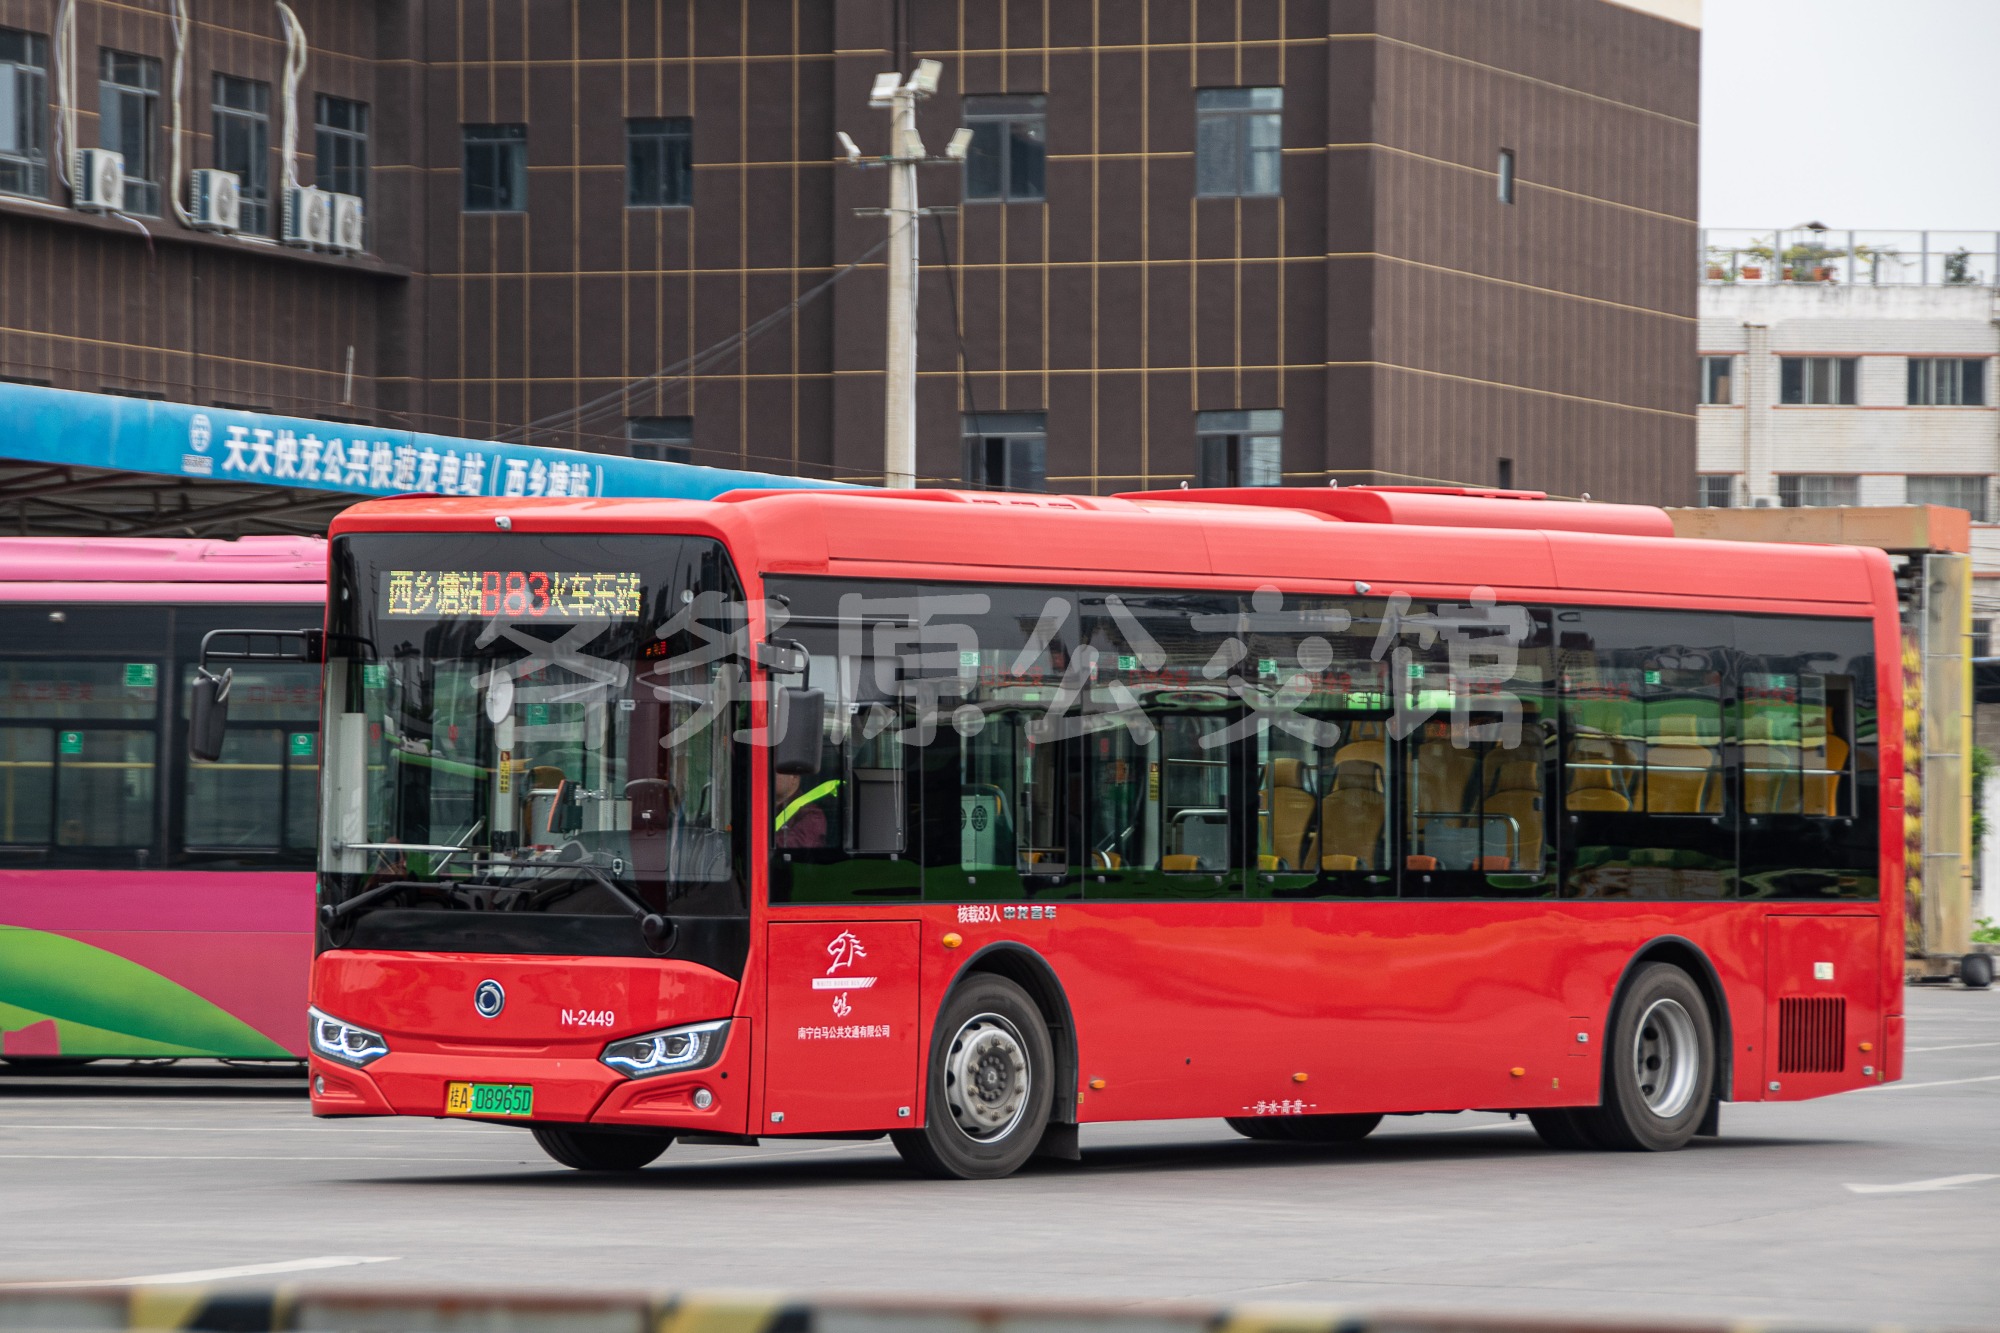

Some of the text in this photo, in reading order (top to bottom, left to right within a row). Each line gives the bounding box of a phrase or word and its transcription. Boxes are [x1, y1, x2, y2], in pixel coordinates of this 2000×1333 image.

[388, 570, 641, 616] 西乡塘站 B83 火车东站
[957, 904, 1002, 923] 核载83人
[561, 1009, 615, 1027] N-2449
[797, 1024, 891, 1040] 南宁白马公共交通有限公司
